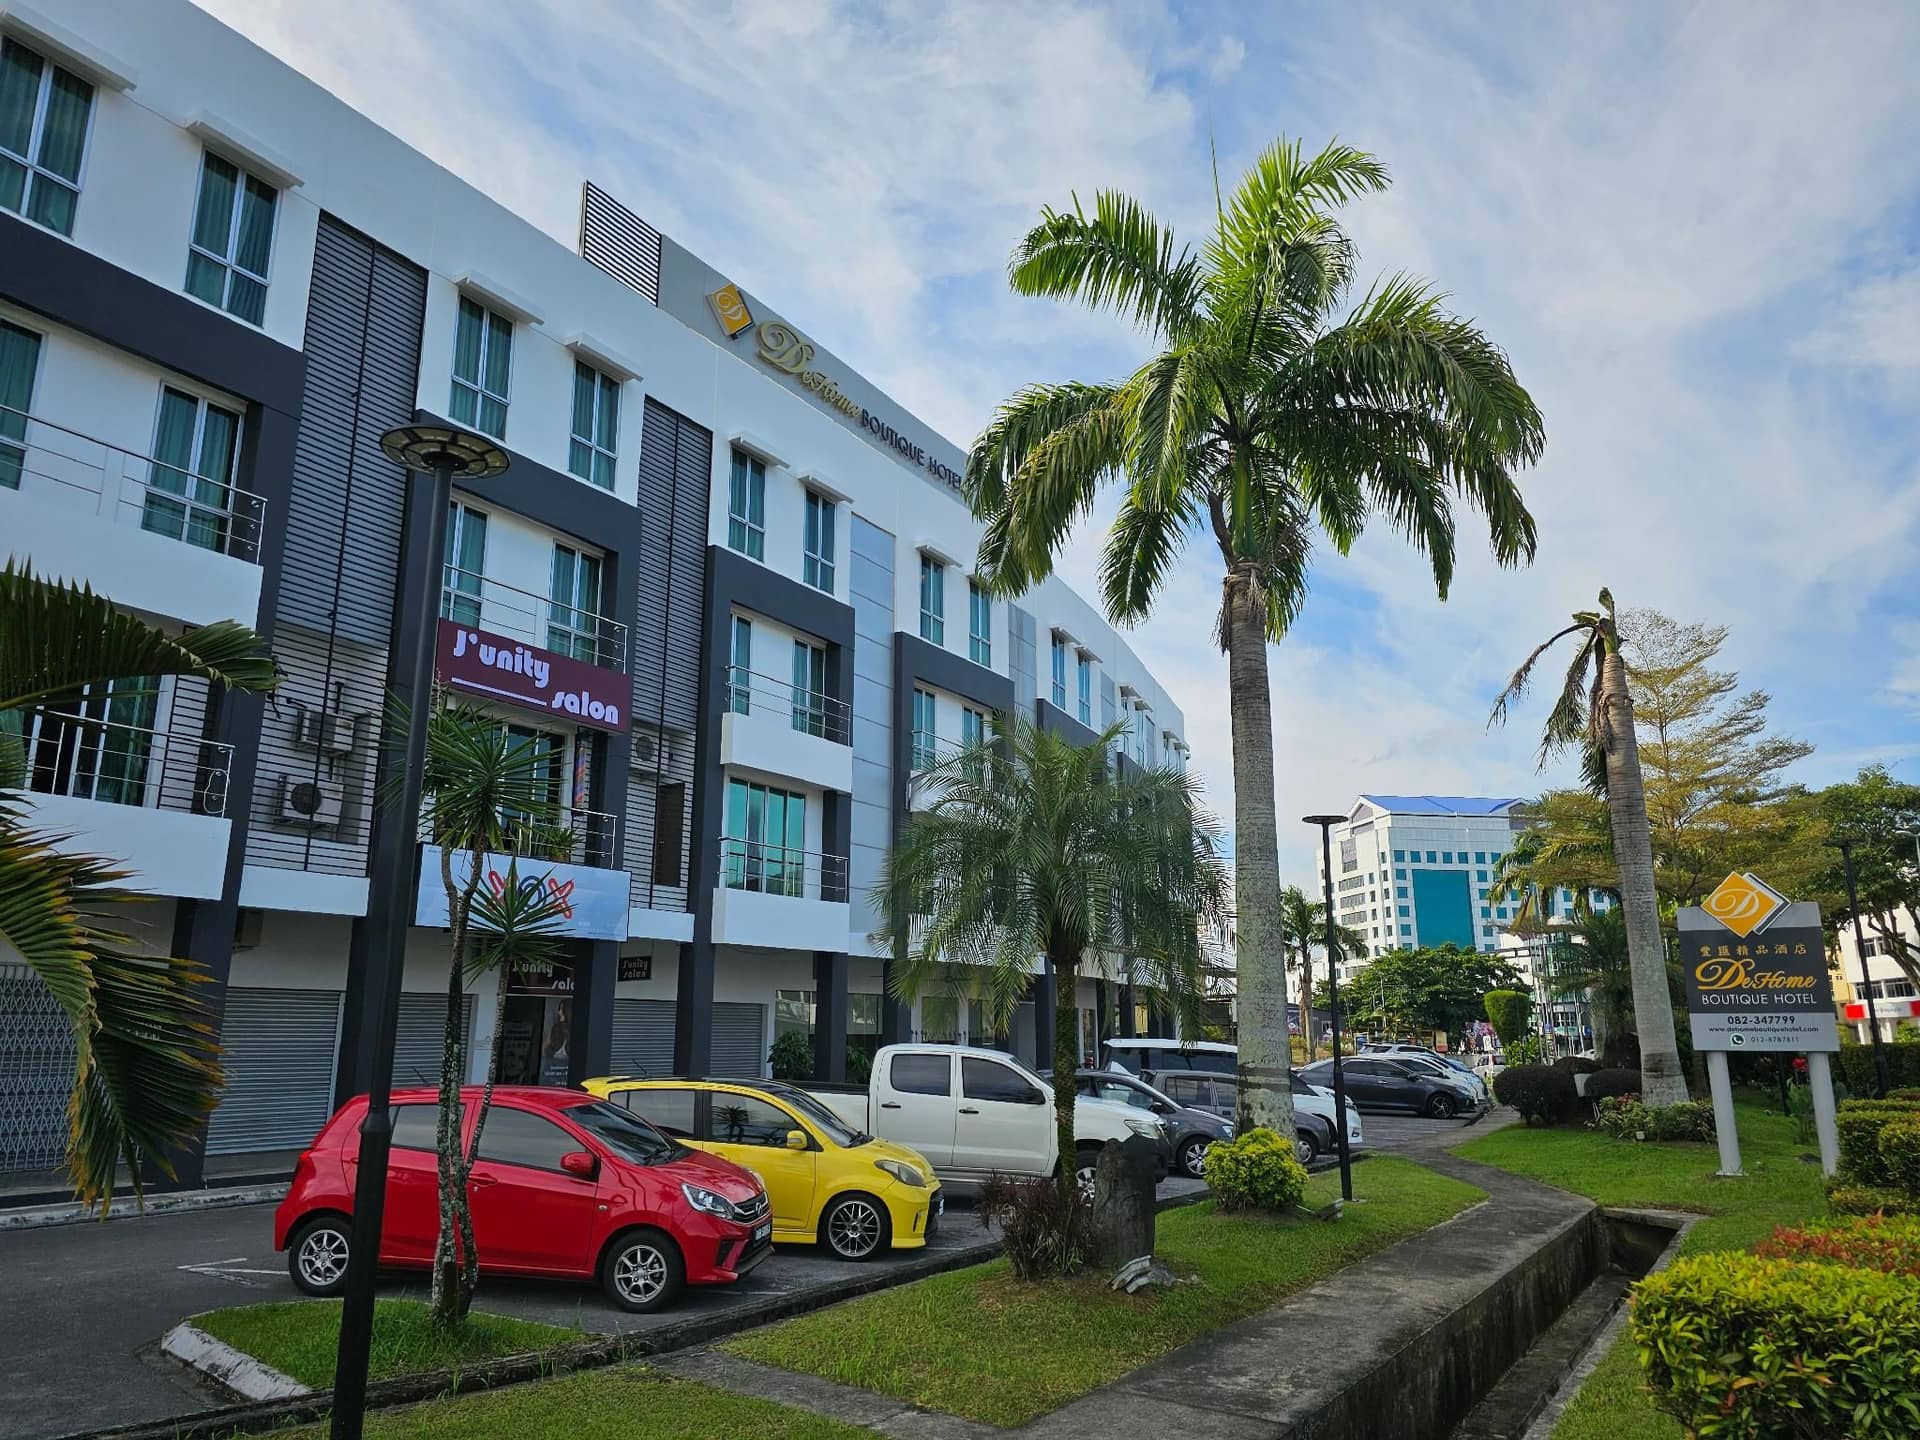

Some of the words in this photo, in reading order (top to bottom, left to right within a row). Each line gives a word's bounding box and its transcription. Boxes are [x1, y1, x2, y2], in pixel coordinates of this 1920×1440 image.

[861, 408, 925, 468] BOUTIQUE
[453, 629, 551, 688] J'unity
[551, 690, 620, 725] salon
[1701, 993, 1769, 1005] BOUTIQUE
[1774, 993, 1817, 1004] HOTEL
[1727, 1015, 1796, 1025] 082-347799
